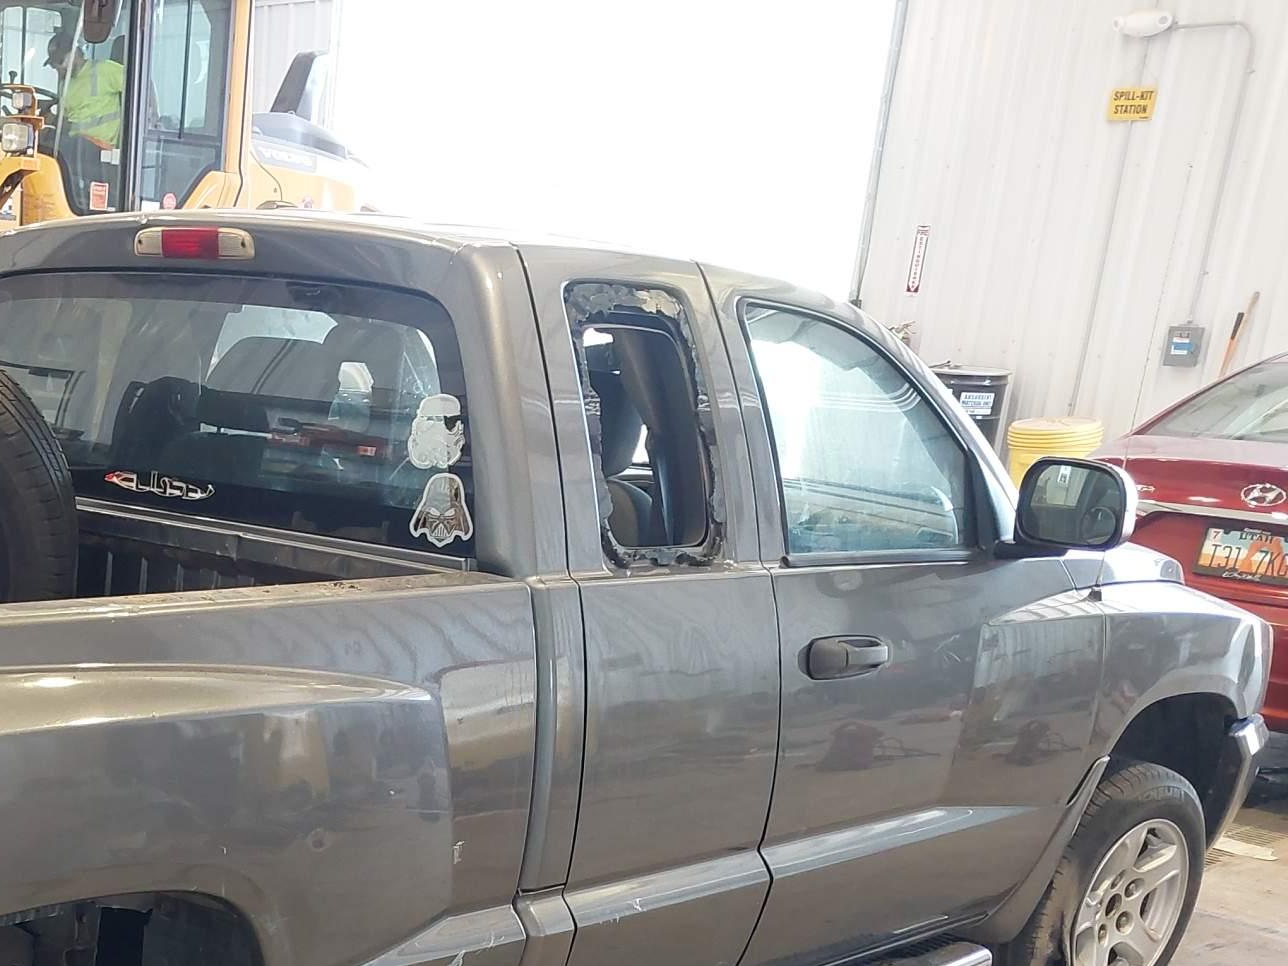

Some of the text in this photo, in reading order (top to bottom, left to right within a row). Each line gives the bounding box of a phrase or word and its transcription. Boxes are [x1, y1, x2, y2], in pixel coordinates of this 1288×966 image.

[1113, 90, 1154, 101] SPILL-KIT
[1113, 104, 1148, 114] STATION
[1239, 531, 1273, 544] UTAH
